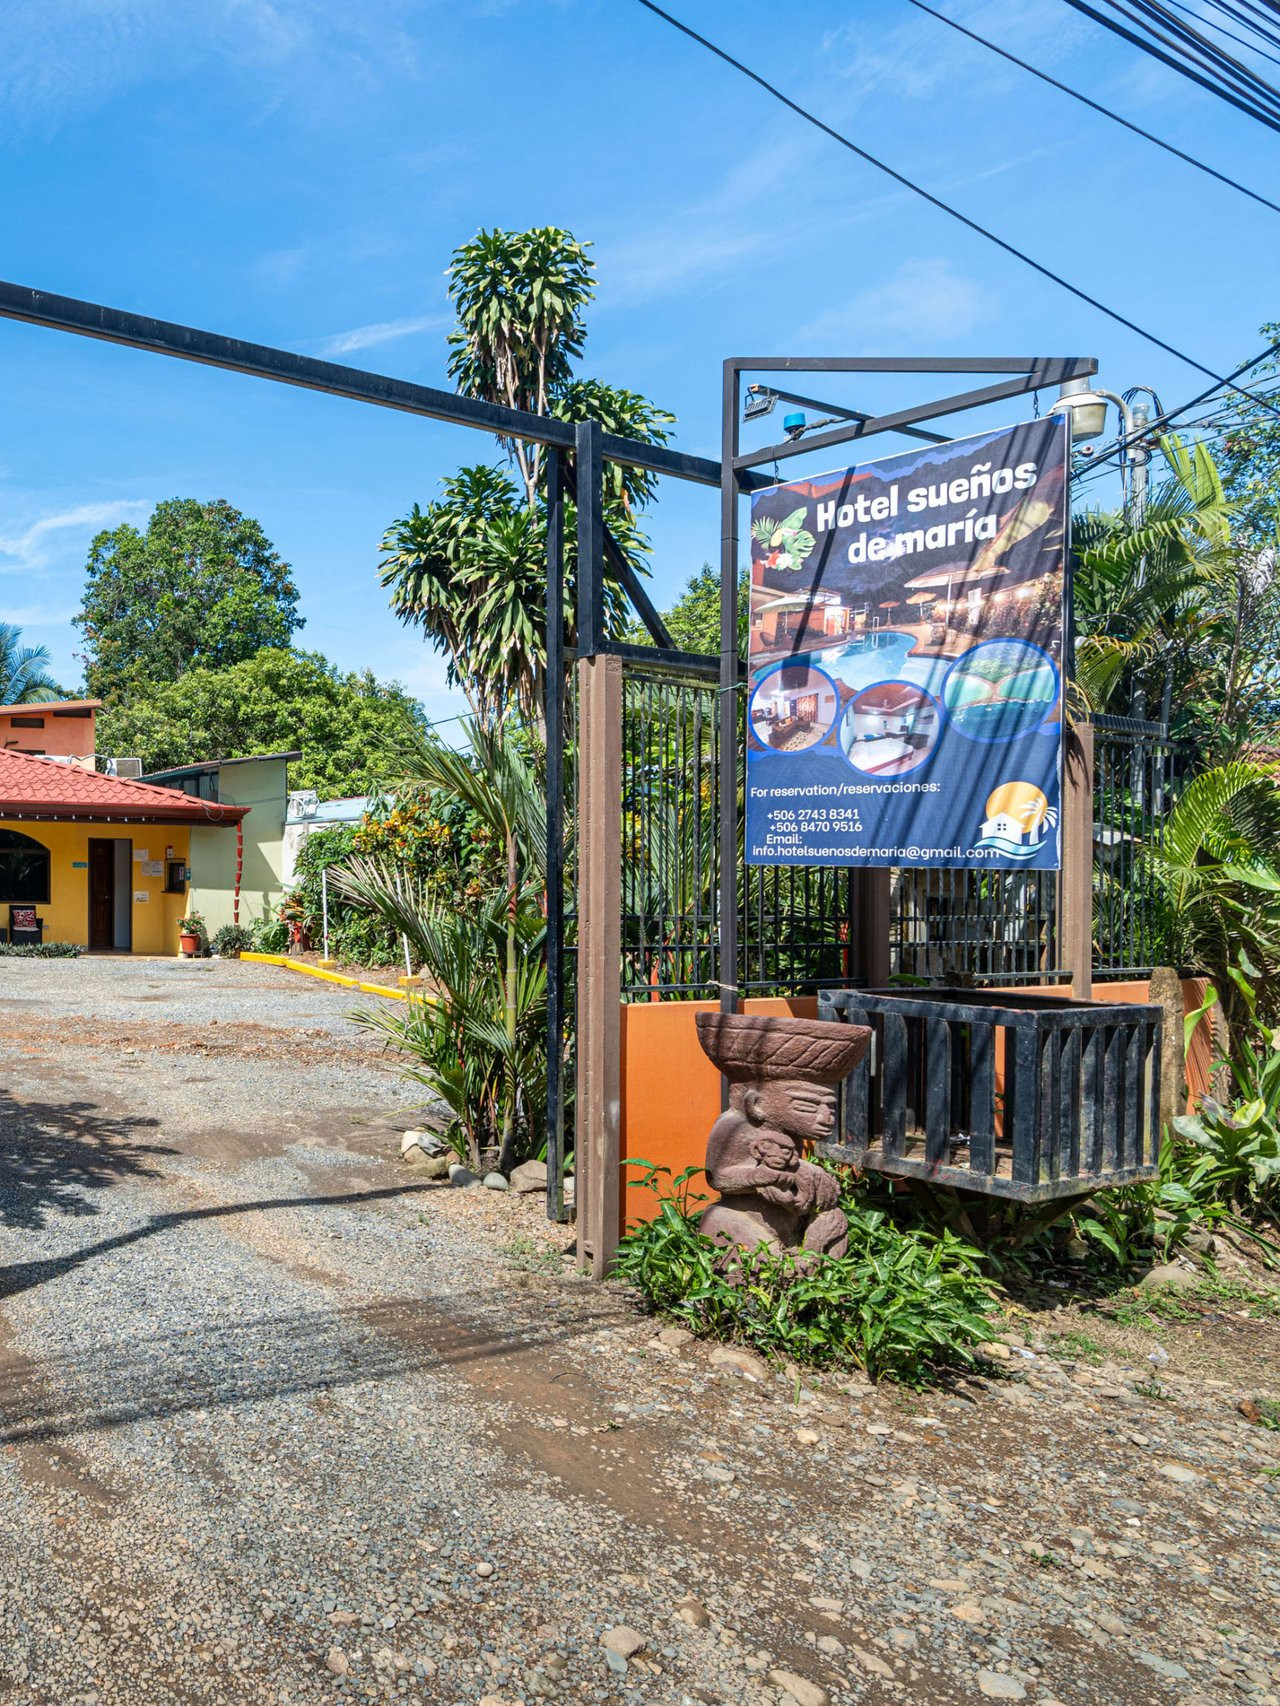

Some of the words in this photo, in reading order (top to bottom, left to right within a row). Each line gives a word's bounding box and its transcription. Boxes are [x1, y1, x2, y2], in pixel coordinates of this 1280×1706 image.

[817, 484, 898, 532] Hotel
[907, 461, 1038, 512] sueños
[848, 533, 885, 564] de
[896, 509, 998, 556] maría
[750, 787, 768, 797] For
[770, 782, 941, 797] reservation/reservaciones:
[767, 810, 795, 820] +506
[797, 809, 827, 820] 2743
[829, 808, 860, 820] 8341
[770, 822, 798, 832] +506
[800, 822, 830, 832] 8470
[832, 821, 862, 832] 9516
[766, 834, 802, 844] Email:
[752, 845, 1000, 861] info.hotelsuenosdemaria@gmail.com
